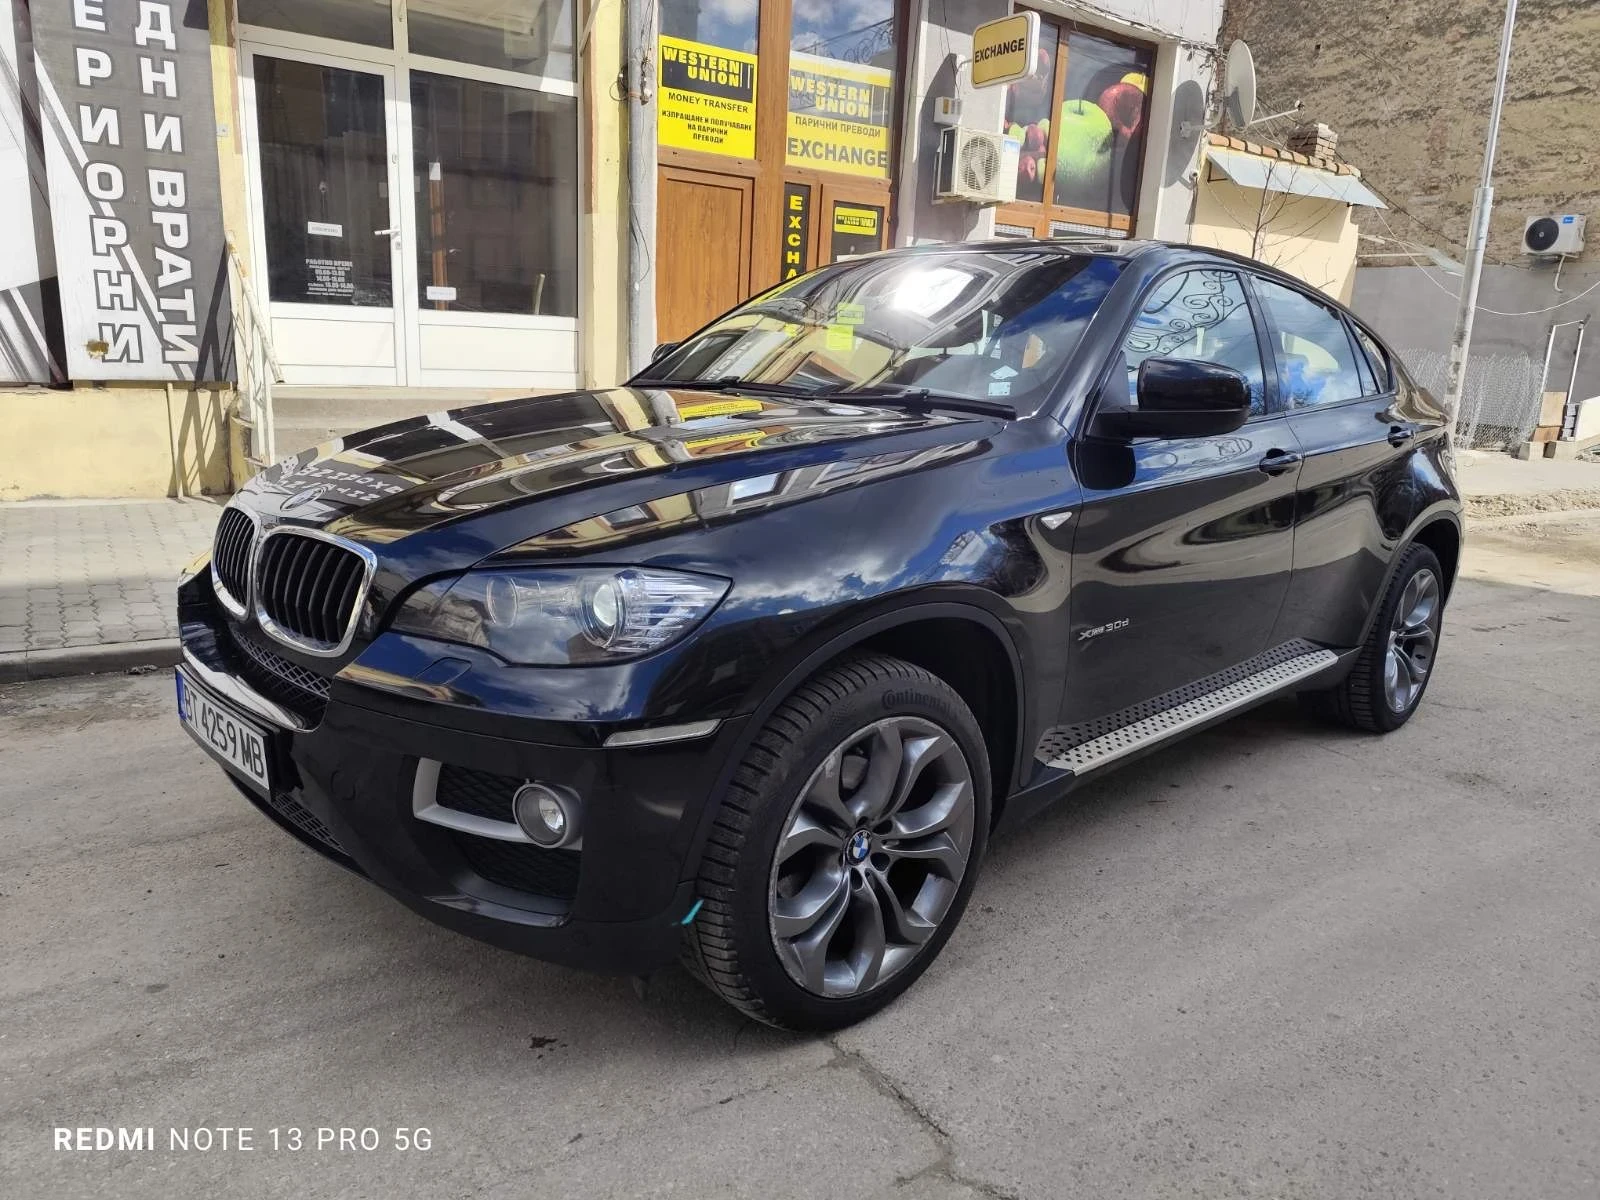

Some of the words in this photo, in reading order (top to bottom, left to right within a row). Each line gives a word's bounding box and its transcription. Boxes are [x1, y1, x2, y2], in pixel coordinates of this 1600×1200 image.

[663, 46, 740, 74] WESTERN
[974, 38, 1025, 64] EXCHANGE
[687, 65, 740, 88] UNION
[790, 75, 870, 104] WESTERN
[668, 92, 700, 105] MONEY
[704, 98, 749, 113] TRANSFER
[815, 95, 869, 118] UNION
[661, 110, 703, 123] ИЗПРАЩАНЕ
[795, 116, 838, 131] ПАРИЧНИ
[840, 123, 881, 138] ПРЕВОДИ
[687, 123, 697, 131] НА
[697, 124, 728, 136] ПАРИЧНИ
[692, 133, 724, 144] ПРЕВОДИ
[787, 137, 889, 168] EXCHANGE
[149, 169, 199, 362] ВРАТИ
[881, 688, 952, 715] Continental
[201, 702, 237, 759] 4259
